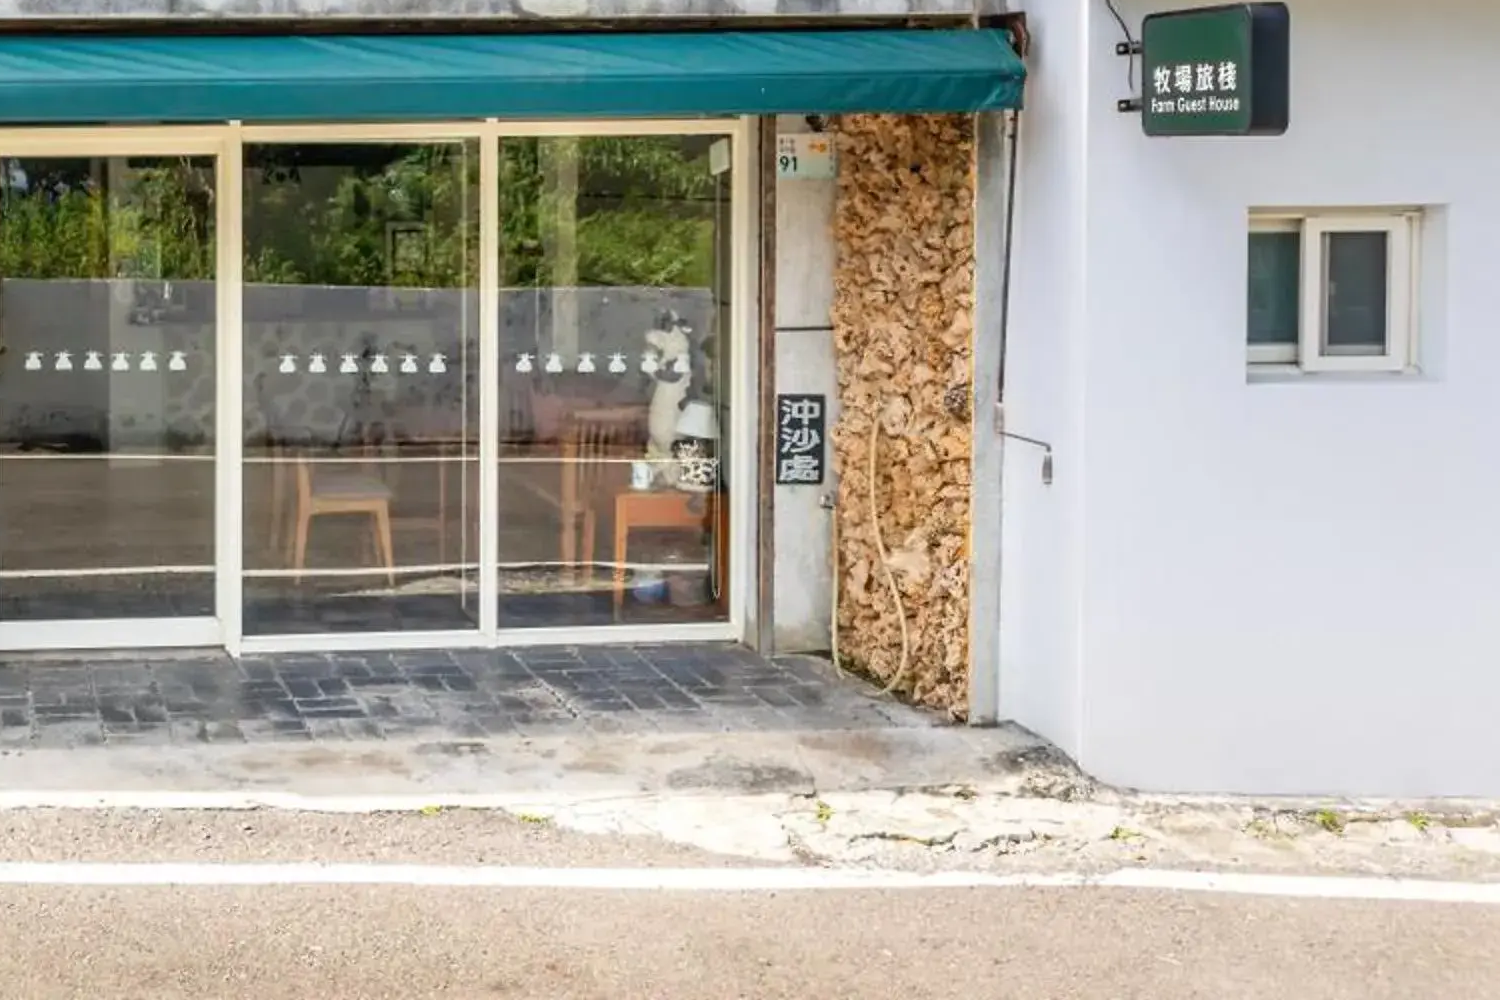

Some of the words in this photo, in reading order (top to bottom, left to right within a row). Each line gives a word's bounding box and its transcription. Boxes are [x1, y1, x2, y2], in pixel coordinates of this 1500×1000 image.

[1151, 97, 1175, 113] Farm
[1177, 97, 1207, 113] Guest
[1208, 96, 1240, 112] House
[779, 155, 797, 172] 91
